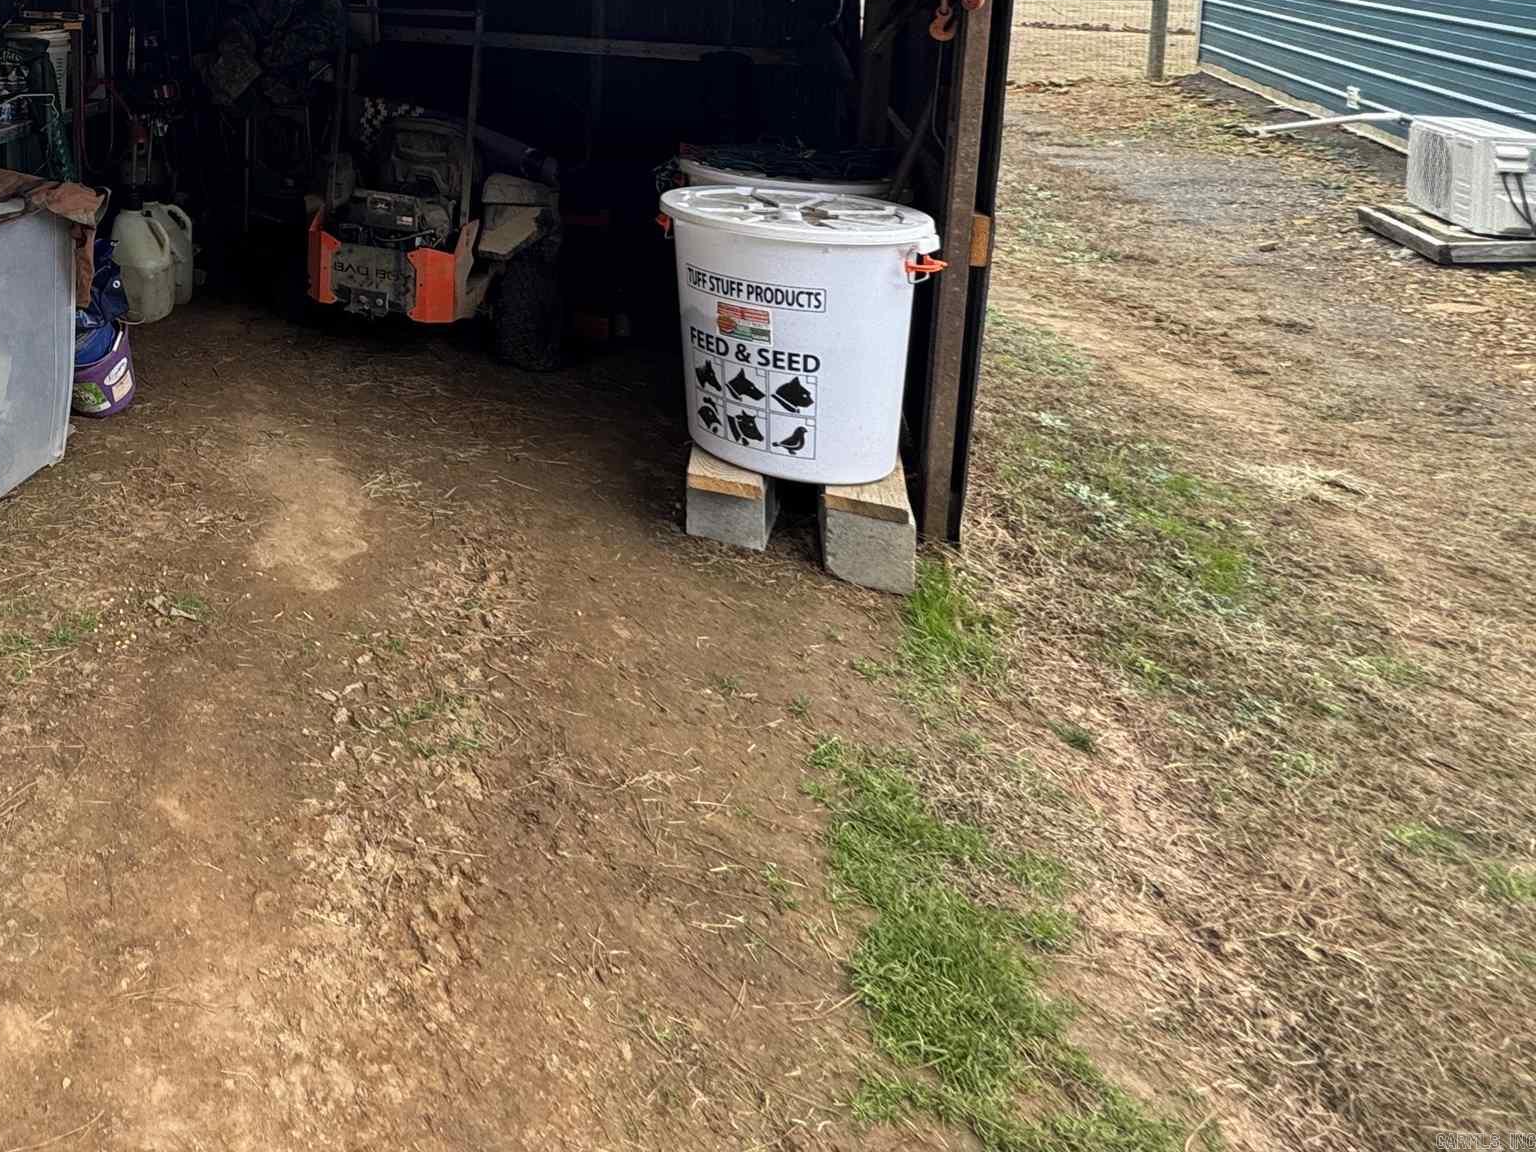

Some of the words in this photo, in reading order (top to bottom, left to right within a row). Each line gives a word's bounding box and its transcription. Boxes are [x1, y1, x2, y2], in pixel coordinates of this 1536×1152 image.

[333, 260, 368, 276] BAD
[687, 267, 707, 289] TUFF
[708, 273, 744, 298] STUFF
[746, 283, 822, 309] PRODUCTS
[689, 326, 730, 357] FEED
[734, 343, 752, 364] &
[757, 348, 821, 374] SEED
